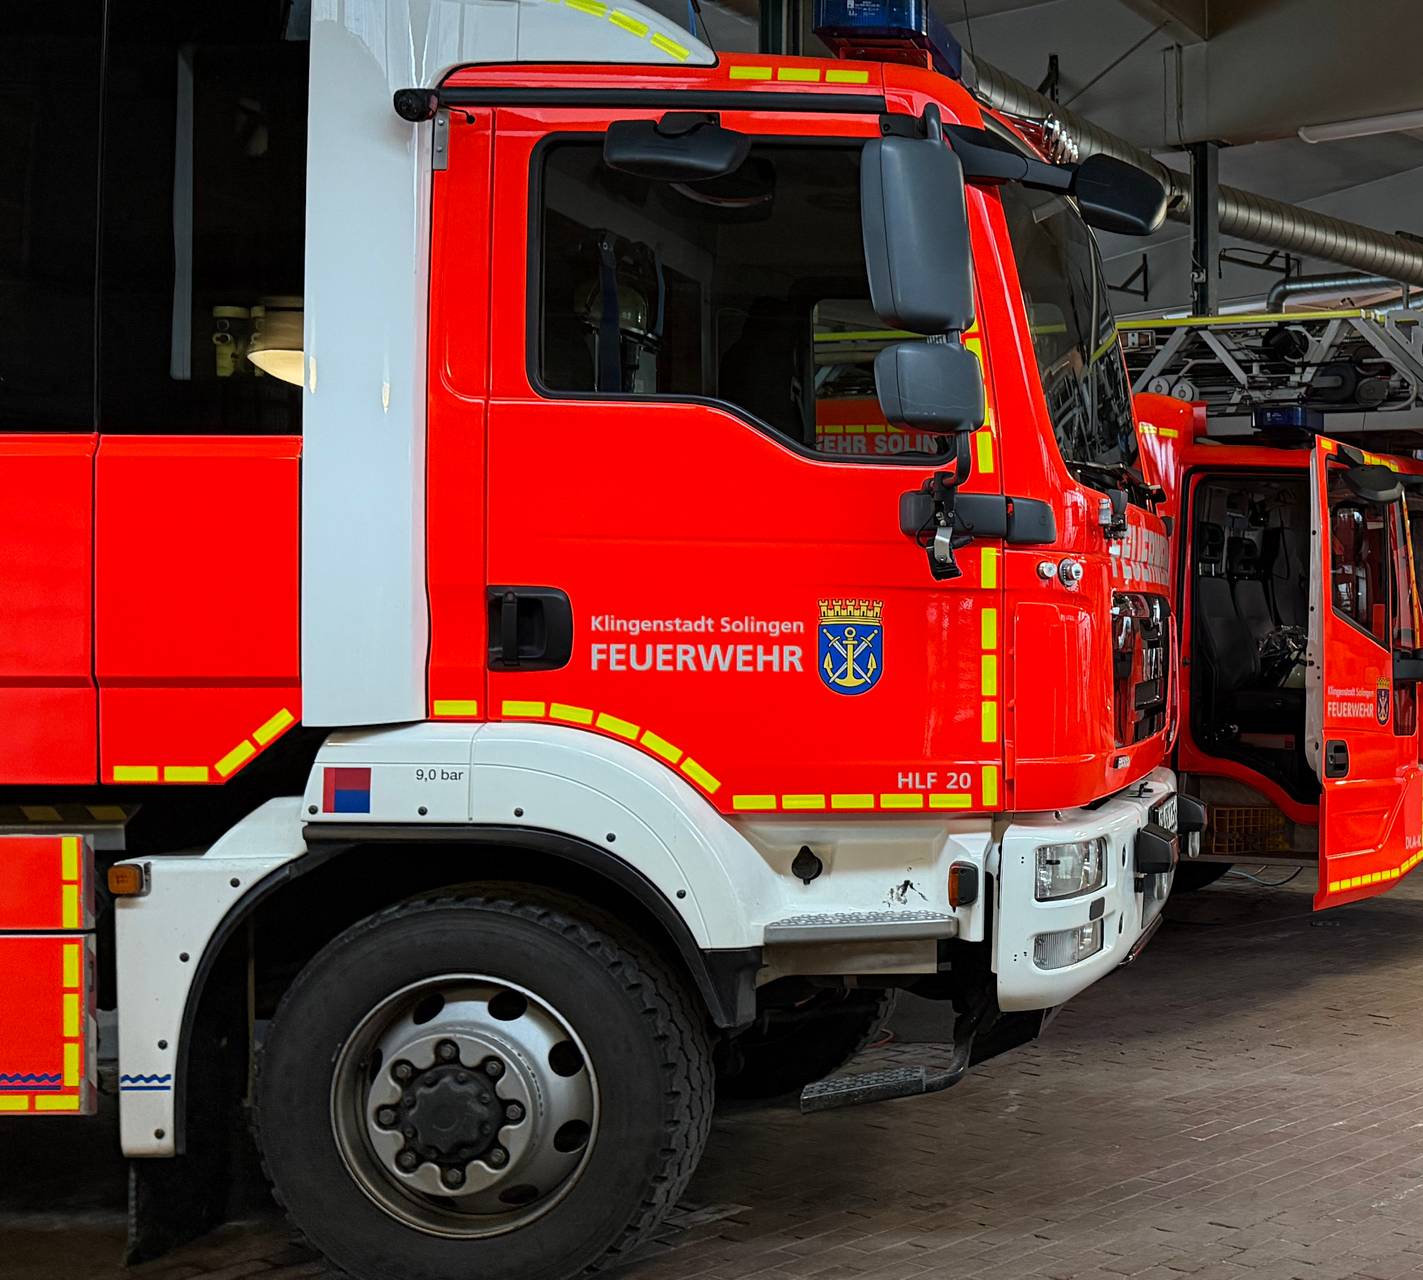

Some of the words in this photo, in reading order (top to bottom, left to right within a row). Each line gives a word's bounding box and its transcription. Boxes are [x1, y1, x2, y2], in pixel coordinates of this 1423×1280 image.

[591, 615, 714, 636] Klingenstadt
[720, 616, 805, 637] Solingen
[590, 643, 804, 672] FEUERWEHR
[1327, 701, 1374, 719] FEUERWEHR
[415, 768, 437, 782] 9,0
[440, 768, 465, 781] bar
[897, 771, 938, 789] HLF
[945, 771, 972, 789] 20
